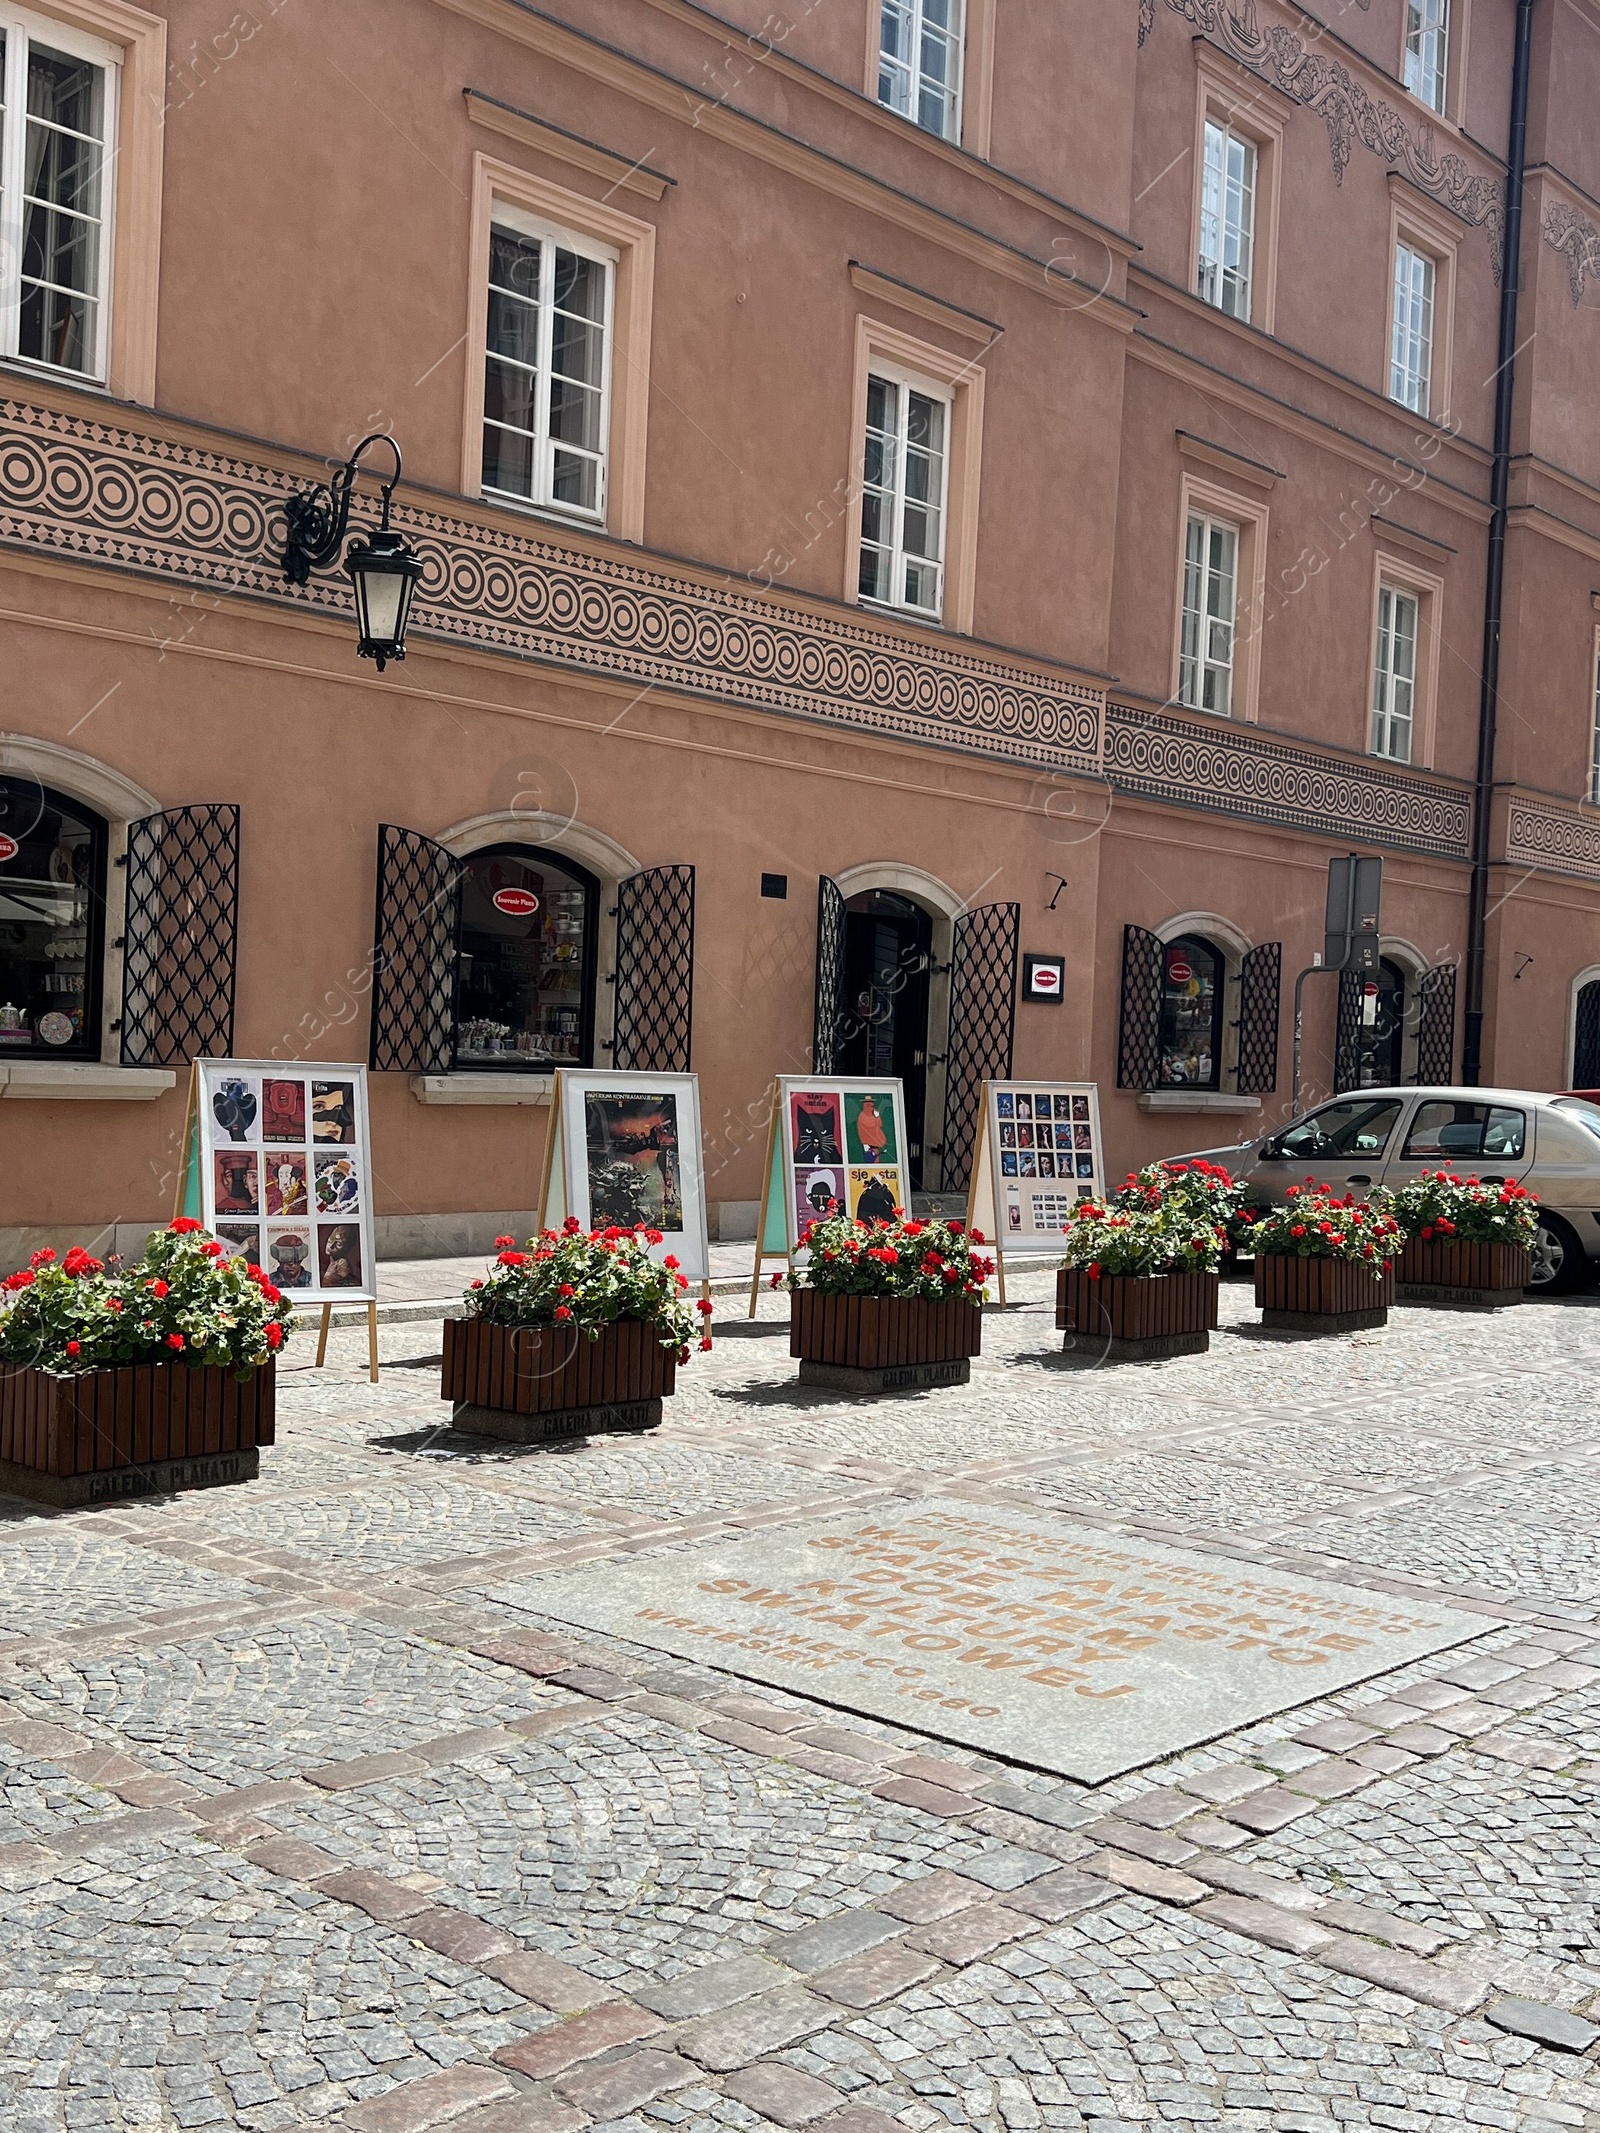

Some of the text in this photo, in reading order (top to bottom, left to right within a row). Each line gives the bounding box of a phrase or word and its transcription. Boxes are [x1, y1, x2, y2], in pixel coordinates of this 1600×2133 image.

[851, 1168, 897, 1181] sje sta
[169, 1457, 240, 1489] PLAKATU
[904, 1518, 1131, 1572] DZIEDZICTWA
[806, 1536, 1330, 1666] STARE MIASTO
[850, 1568, 1163, 1652] DOBREM
[853, 1525, 1374, 1653] WARSZAWSKIE
[1233, 1580, 1442, 1629] KOMITETU
[794, 1578, 1132, 1665] KULTURY
[750, 1625, 928, 1678] UNESCO
[896, 1683, 1001, 1719] 1980
